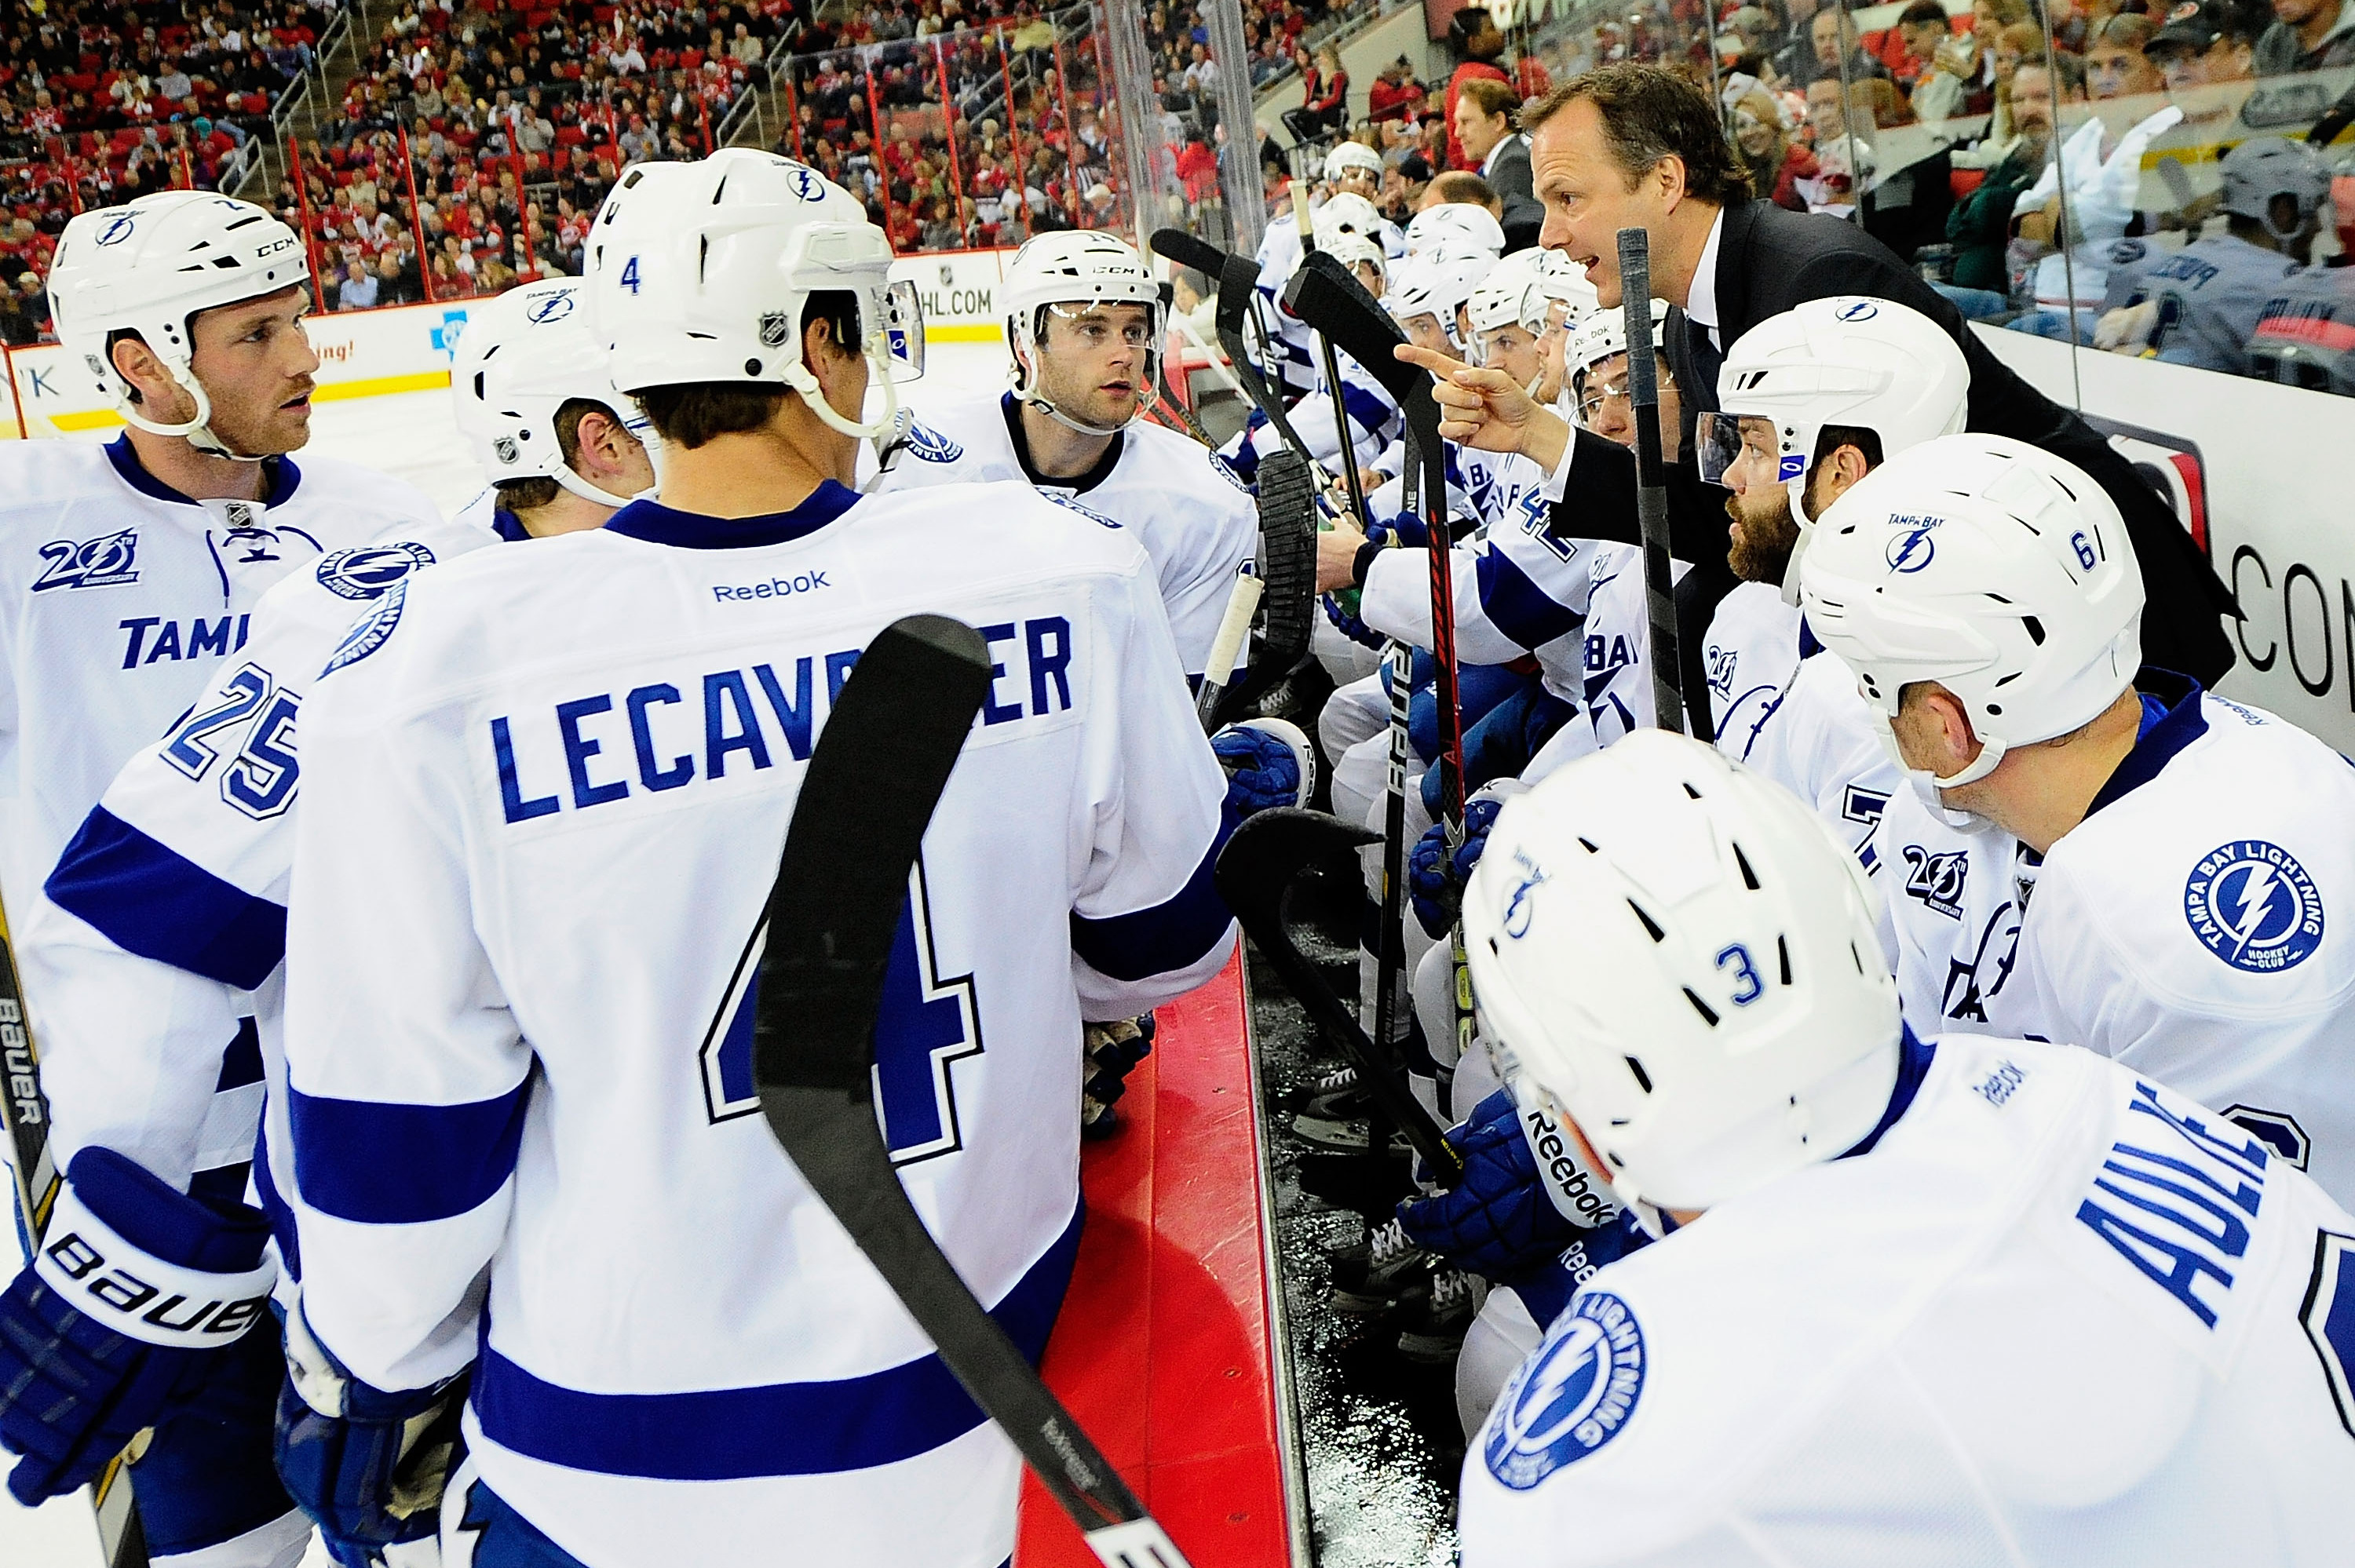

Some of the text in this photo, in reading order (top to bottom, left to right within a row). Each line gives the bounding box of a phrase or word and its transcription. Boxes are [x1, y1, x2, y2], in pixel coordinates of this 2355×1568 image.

[255, 237, 296, 257] CCM
[619, 255, 641, 296] 4
[921, 288, 991, 317] HL.COM
[1888, 512, 1948, 528] TAMPA BAY
[2070, 530, 2097, 573] 6
[712, 570, 832, 603] Reebok
[2232, 544, 2355, 713] CO
[159, 661, 302, 821] 25
[490, 615, 1072, 825] LECAVER
[2188, 842, 2321, 949] TAMPA BAY LIGHTNING
[1716, 943, 1765, 1007] 3
[2247, 945, 2290, 961] HOCKEY
[2258, 957, 2285, 969] CLUB
[698, 859, 985, 1169] 4
[0, 998, 42, 1125] BAUER
[1527, 1110, 1616, 1224] Reebok
